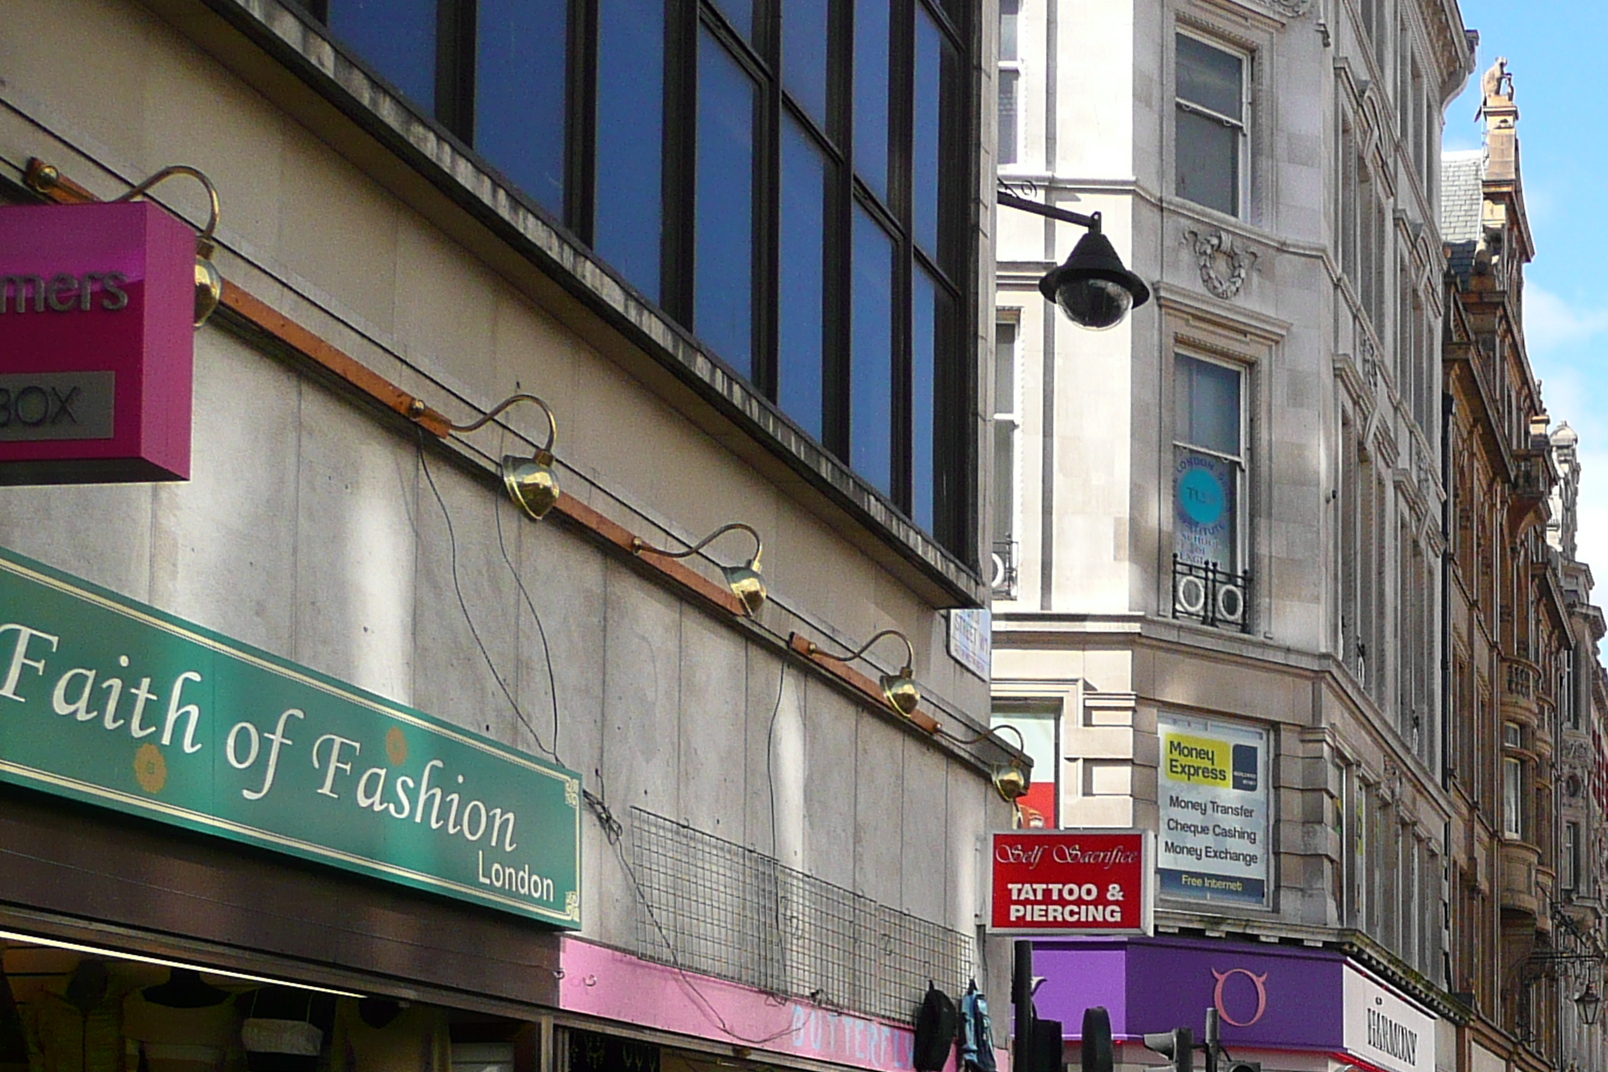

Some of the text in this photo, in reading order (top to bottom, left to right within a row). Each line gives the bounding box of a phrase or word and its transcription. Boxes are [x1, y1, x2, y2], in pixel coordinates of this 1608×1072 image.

[0, 623, 517, 852] Faith of Fashion
[1169, 740, 1215, 765] Money
[1169, 759, 1226, 781] Express
[1169, 795, 1254, 818] Money Transfer
[1167, 818, 1257, 844] Cheque Cashing
[996, 844, 1138, 870] Self Sacrifice
[1165, 841, 1258, 866] Money Exchange
[478, 850, 554, 902] London
[1181, 874, 1203, 887] Free
[1008, 883, 1124, 901] TATTOO &
[1009, 905, 1122, 922] PIERCING
[1368, 1008, 1418, 1067] HARMONY
